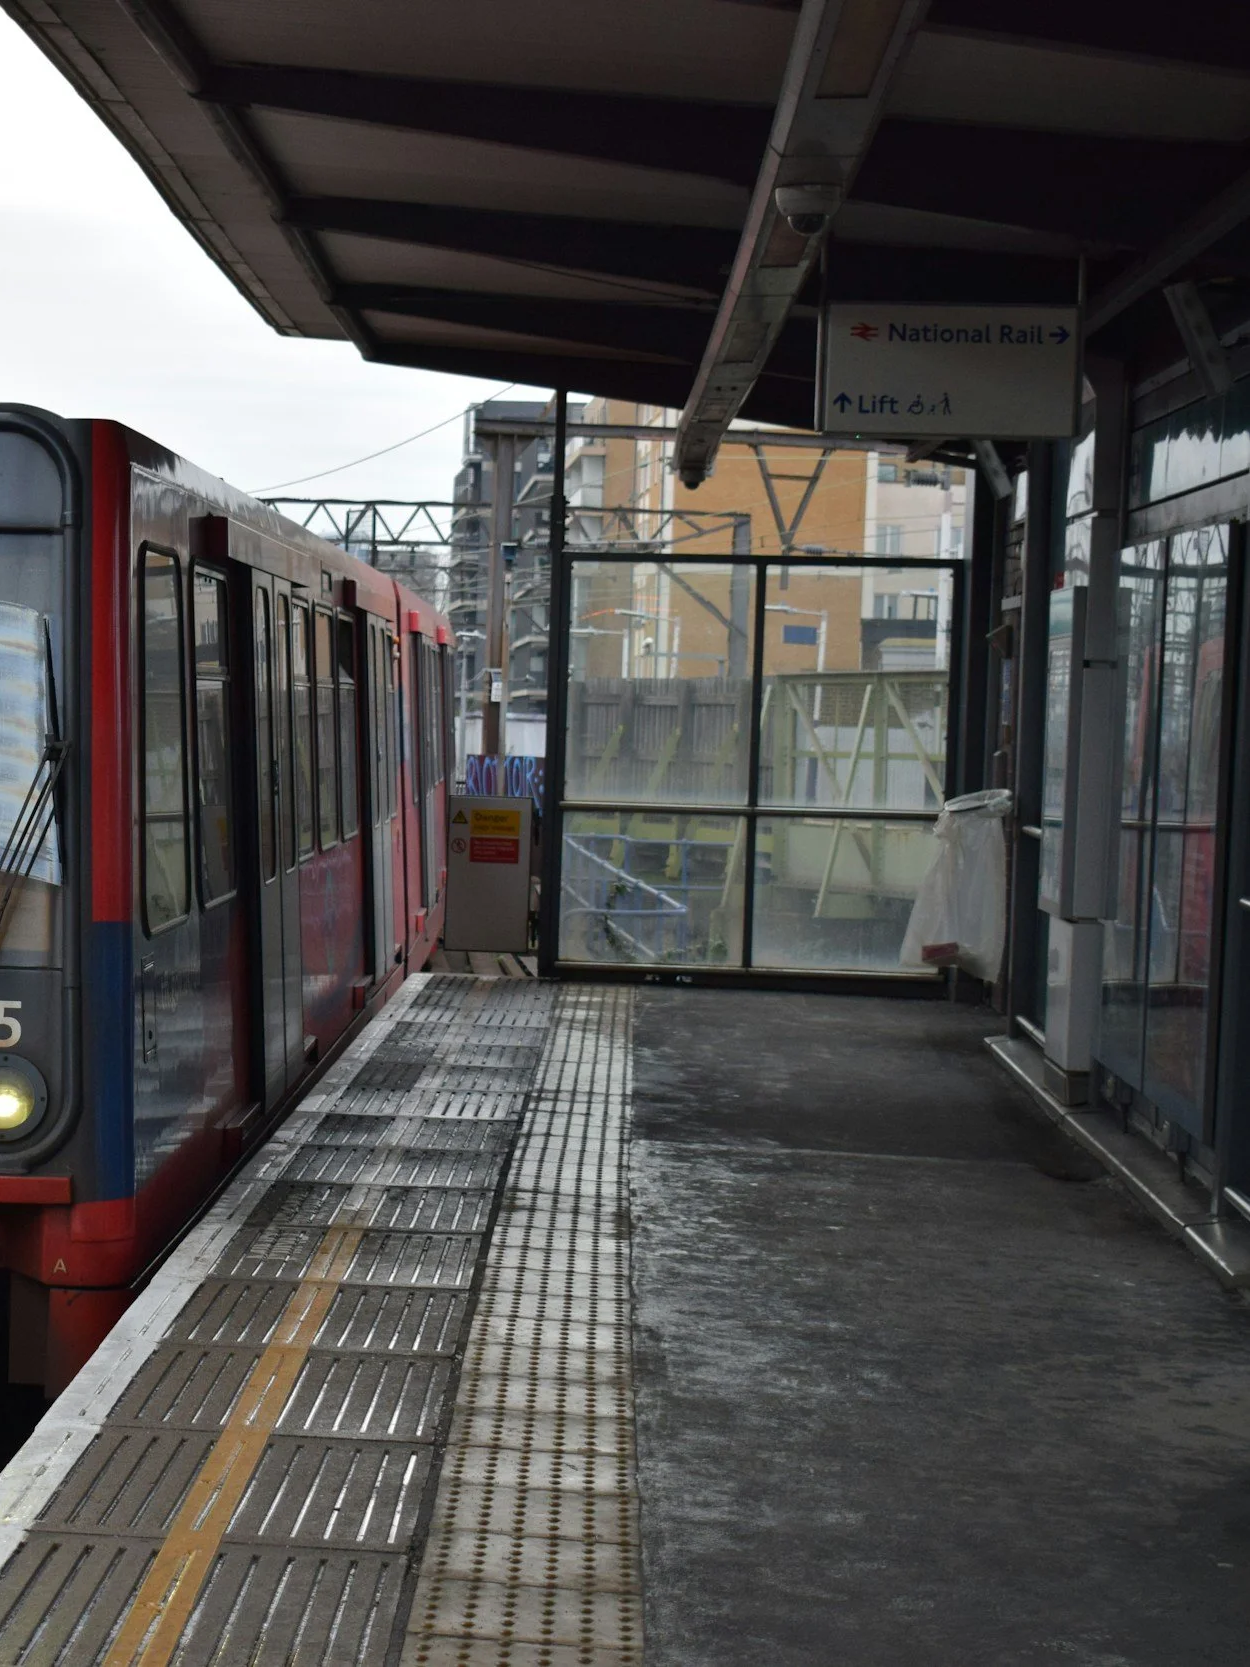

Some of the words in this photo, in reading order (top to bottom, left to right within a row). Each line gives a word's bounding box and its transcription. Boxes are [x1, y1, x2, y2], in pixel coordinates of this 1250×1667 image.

[888, 323, 992, 343] National
[1000, 325, 1044, 344] Rail
[858, 394, 899, 414] Lift
[474, 812, 509, 823] Danger
[53, 1257, 67, 1274] A
